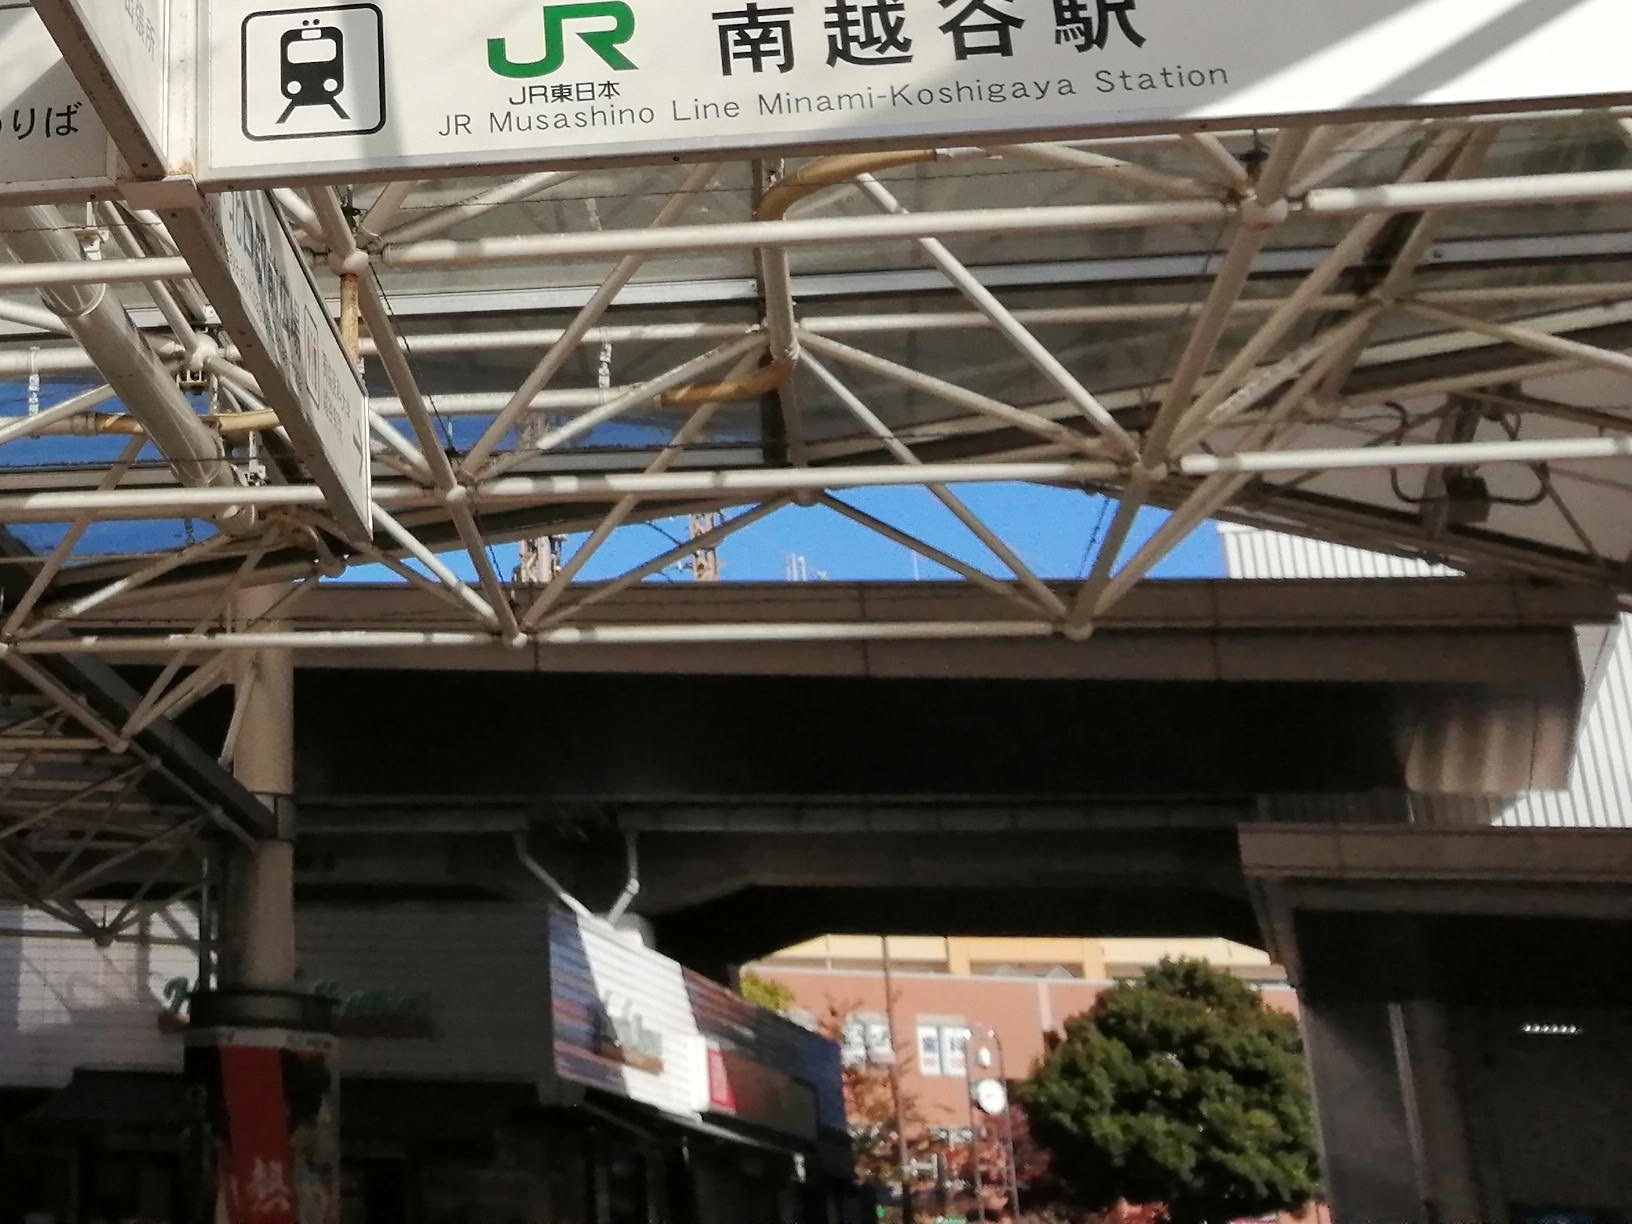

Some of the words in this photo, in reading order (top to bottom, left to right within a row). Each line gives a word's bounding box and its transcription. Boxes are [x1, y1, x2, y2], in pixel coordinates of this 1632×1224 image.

[487, 0, 639, 78] JR
[438, 114, 472, 137] JR
[489, 105, 655, 134] Musashino
[673, 98, 740, 122] Line
[758, 73, 1076, 118] Minami-Koshigaya
[1095, 62, 1229, 95] Station
[509, 79, 621, 107] JR東日本
